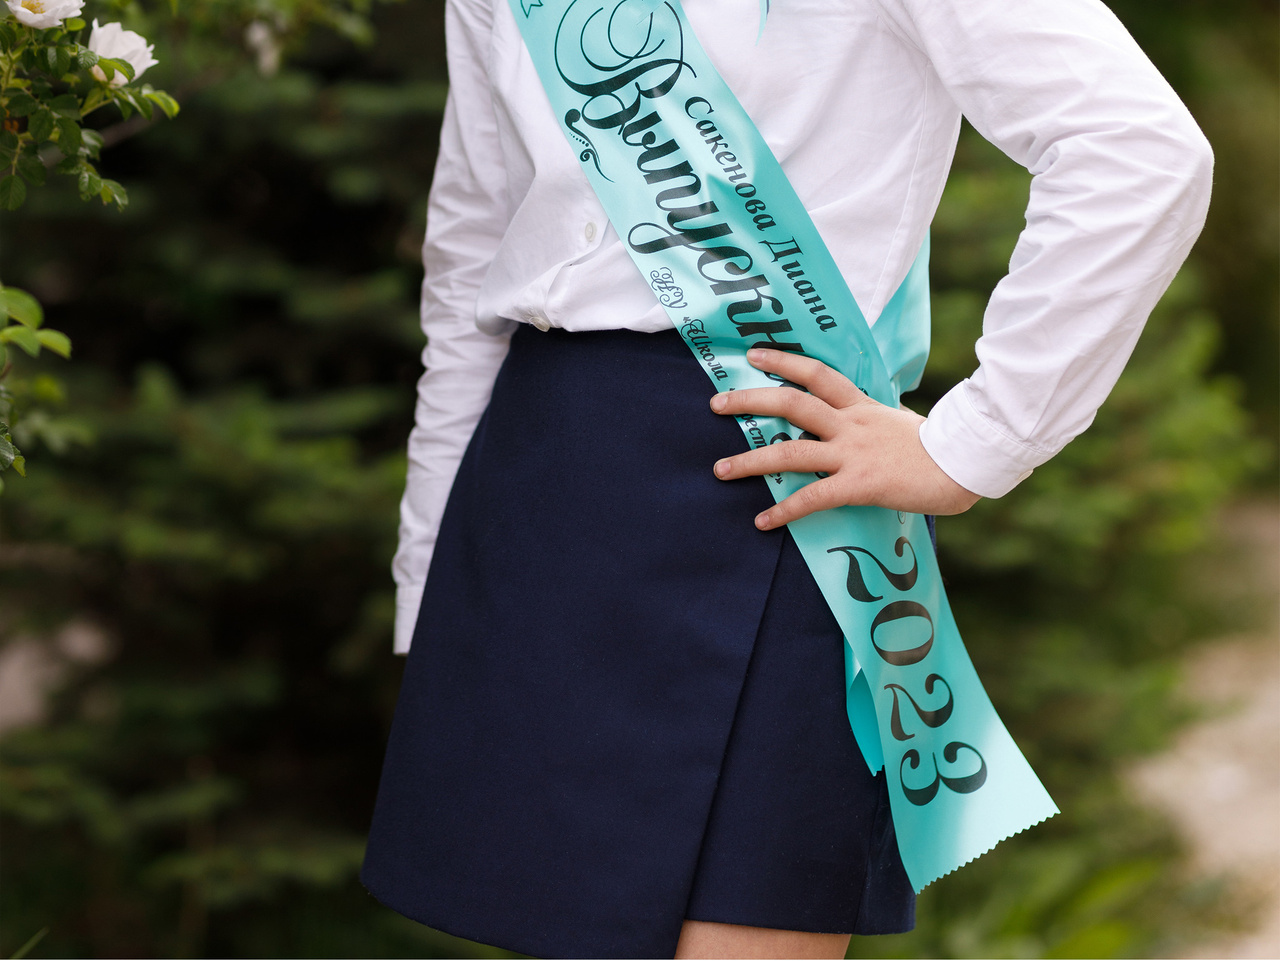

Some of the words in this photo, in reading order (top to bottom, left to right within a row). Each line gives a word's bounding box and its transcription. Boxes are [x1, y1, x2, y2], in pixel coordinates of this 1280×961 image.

[683, 95, 777, 232] Сакенова
[758, 235, 840, 333] Диана
[826, 535, 988, 807] 2023
